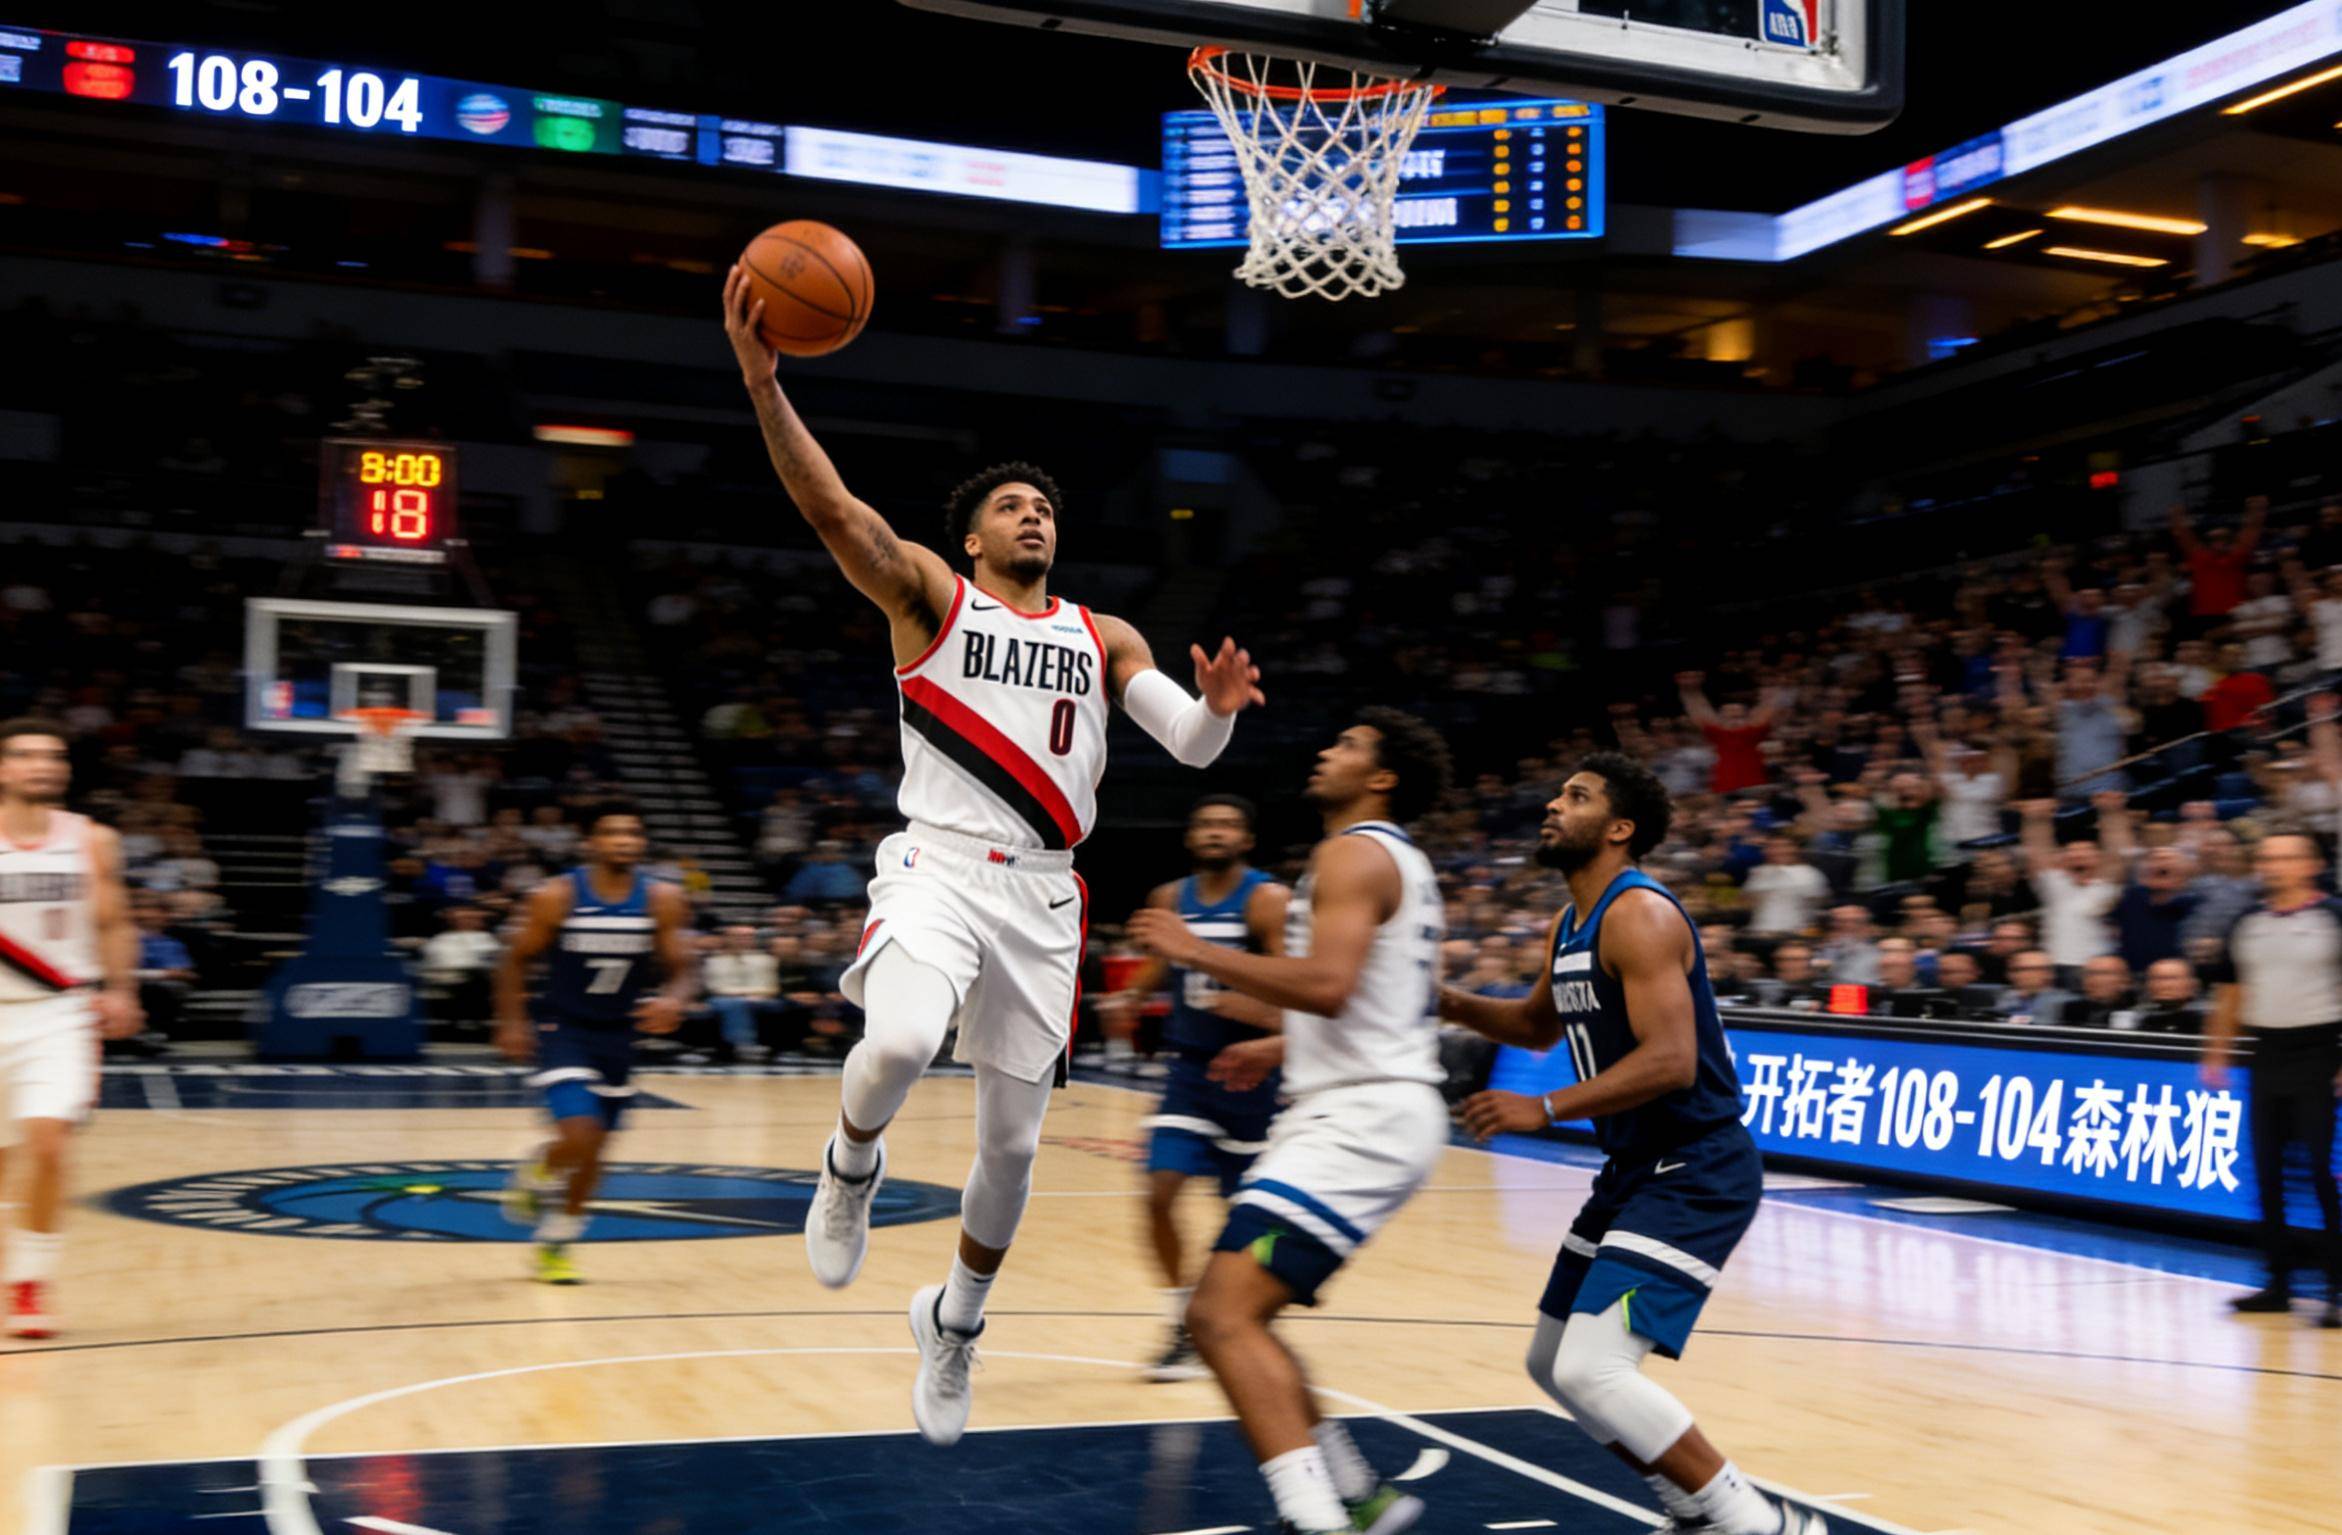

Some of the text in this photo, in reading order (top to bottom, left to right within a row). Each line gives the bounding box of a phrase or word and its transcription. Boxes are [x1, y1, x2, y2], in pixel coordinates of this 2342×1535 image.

[168, 52, 423, 133] 108-104
[361, 452, 441, 487] 8:00
[371, 489, 428, 539] 18
[961, 629, 1093, 696] BLAZERS
[1049, 698, 1076, 756] 0
[584, 958, 634, 994] 7
[1740, 1053, 2242, 1193] 开拓者108-104森林狼
